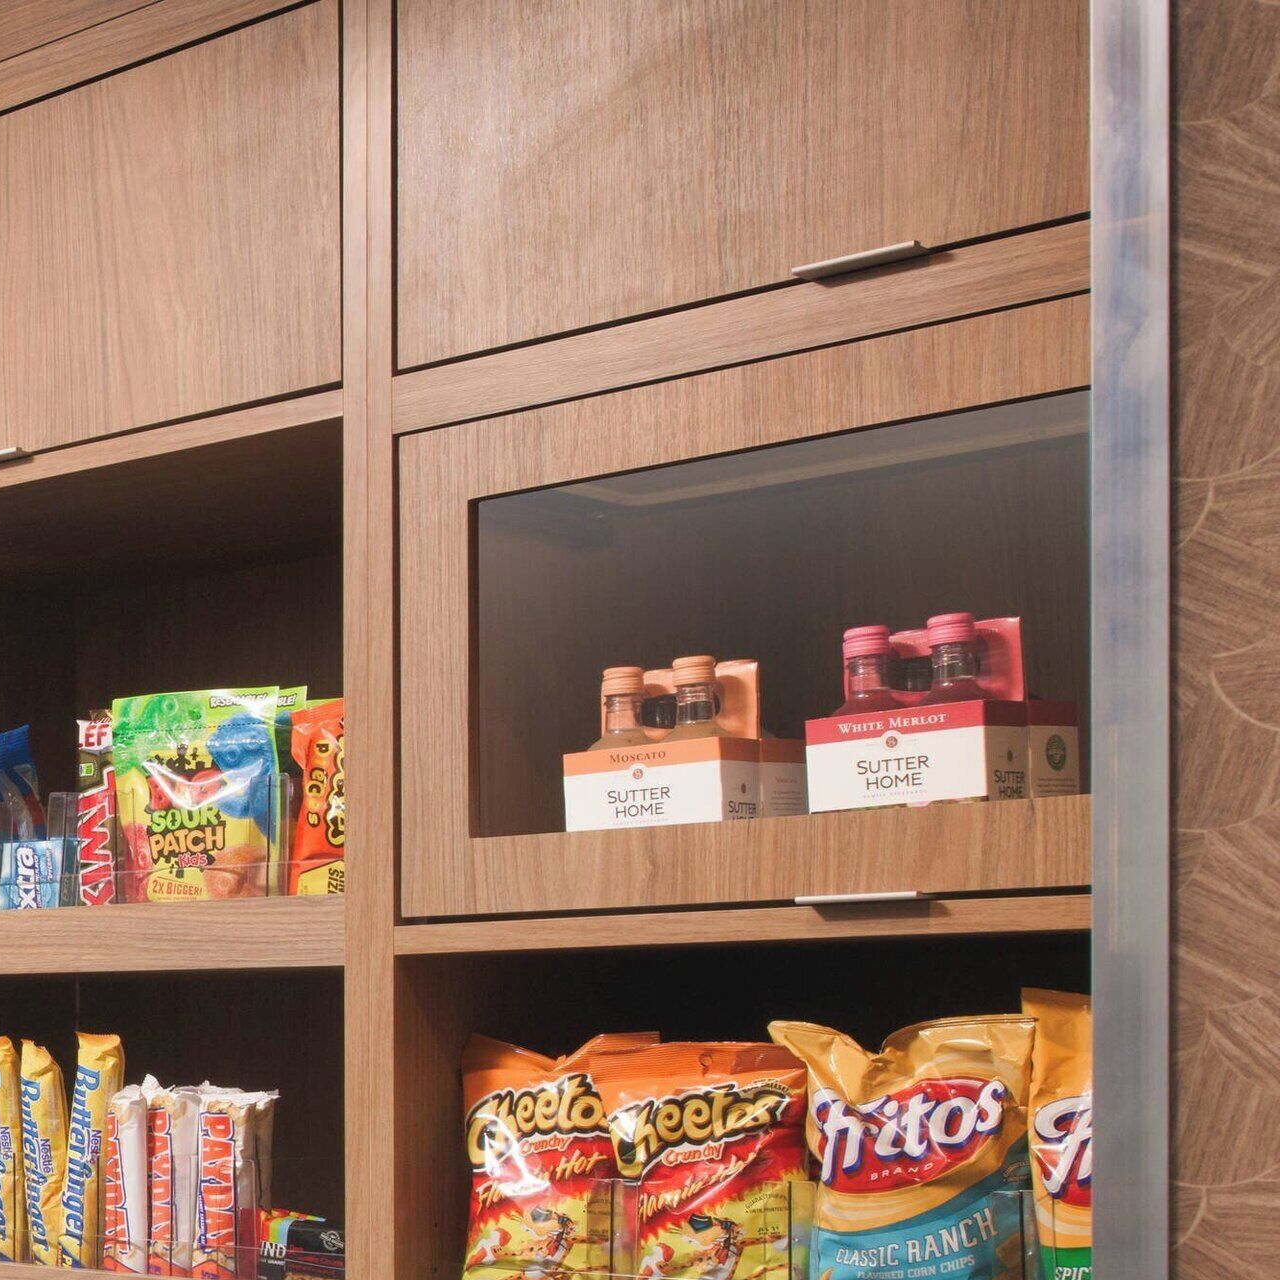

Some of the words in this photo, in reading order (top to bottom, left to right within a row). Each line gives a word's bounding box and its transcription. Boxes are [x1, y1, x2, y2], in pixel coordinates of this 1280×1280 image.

[856, 754, 930, 777] SUTTER
[993, 767, 1026, 786] SUTTER
[864, 772, 924, 790] HOME
[998, 783, 1025, 799] HOME
[607, 785, 671, 804] SUTTER
[151, 806, 220, 831] SOUR
[614, 801, 666, 818] HOME
[727, 800, 757, 816] SUTTER
[149, 826, 225, 857] PATCH
[178, 853, 208, 867] Kids
[152, 880, 165, 894] 2X
[167, 882, 203, 897] BIGGER!
[467, 1077, 610, 1166] Cheeto
[610, 1087, 787, 1179] Cheetos
[812, 1080, 1007, 1186] Fritos
[62, 1064, 100, 1246] Butterfinger
[520, 1134, 571, 1154] Crunchy
[662, 1142, 723, 1166] Crunchy
[21, 1077, 50, 1252] Butterfinger
[555, 1149, 608, 1181] Hot
[871, 1162, 934, 1182] BRAND
[200, 1112, 236, 1252] PAYDAY
[836, 1243, 901, 1268] CLASSIC
[906, 1207, 998, 1261] RANCH
[857, 1269, 904, 1280] FLAVORED
[907, 1265, 937, 1279] CORN
[940, 1255, 976, 1274] CHIPS
